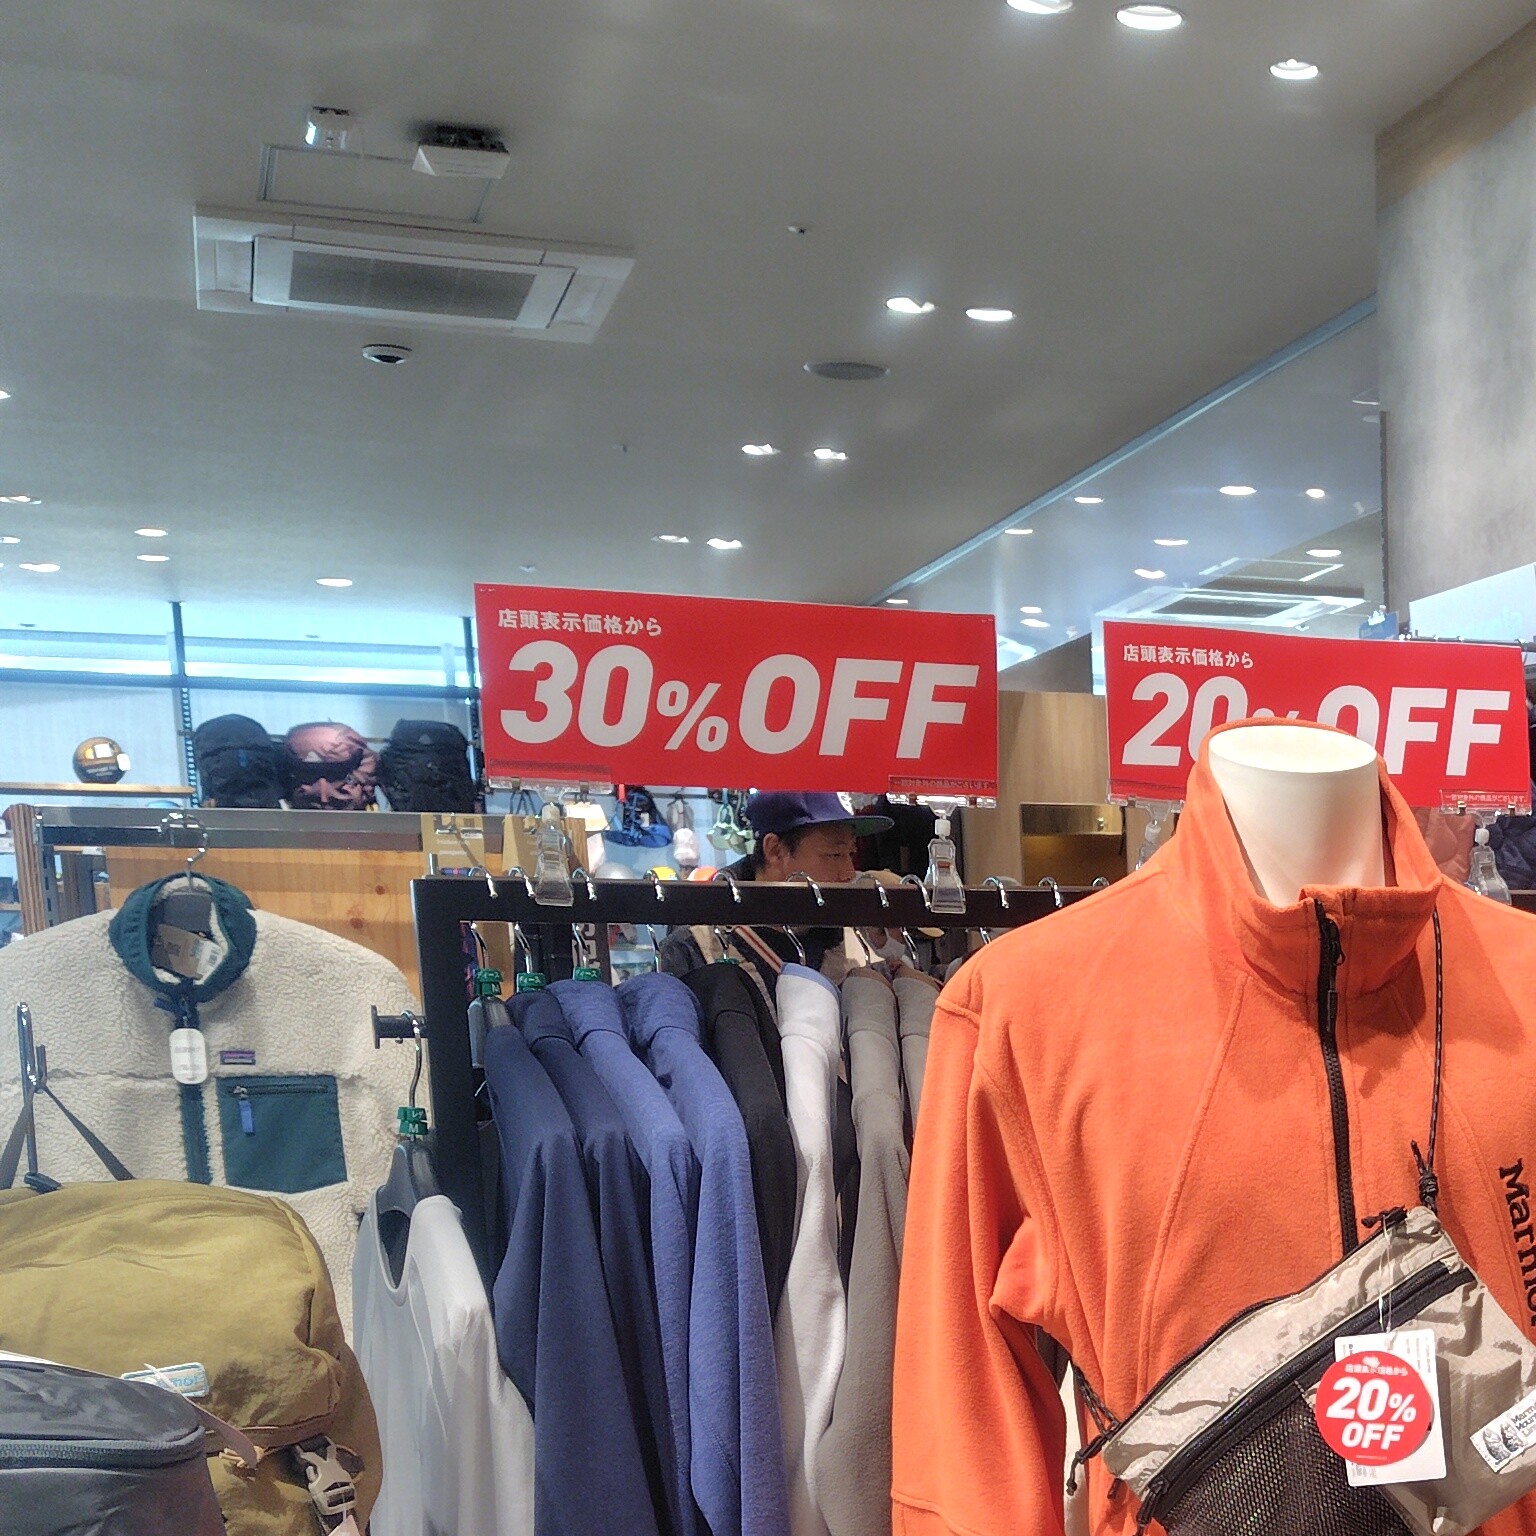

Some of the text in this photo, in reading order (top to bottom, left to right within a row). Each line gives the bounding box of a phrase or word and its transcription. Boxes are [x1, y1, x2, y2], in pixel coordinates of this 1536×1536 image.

[498, 608, 663, 637] 店頭表示価格から
[1122, 643, 1255, 670] 店頭表示価格から
[500, 639, 981, 760] 30%OFF
[1325, 1376, 1417, 1423] 20%
[1341, 1421, 1405, 1450] OFF
